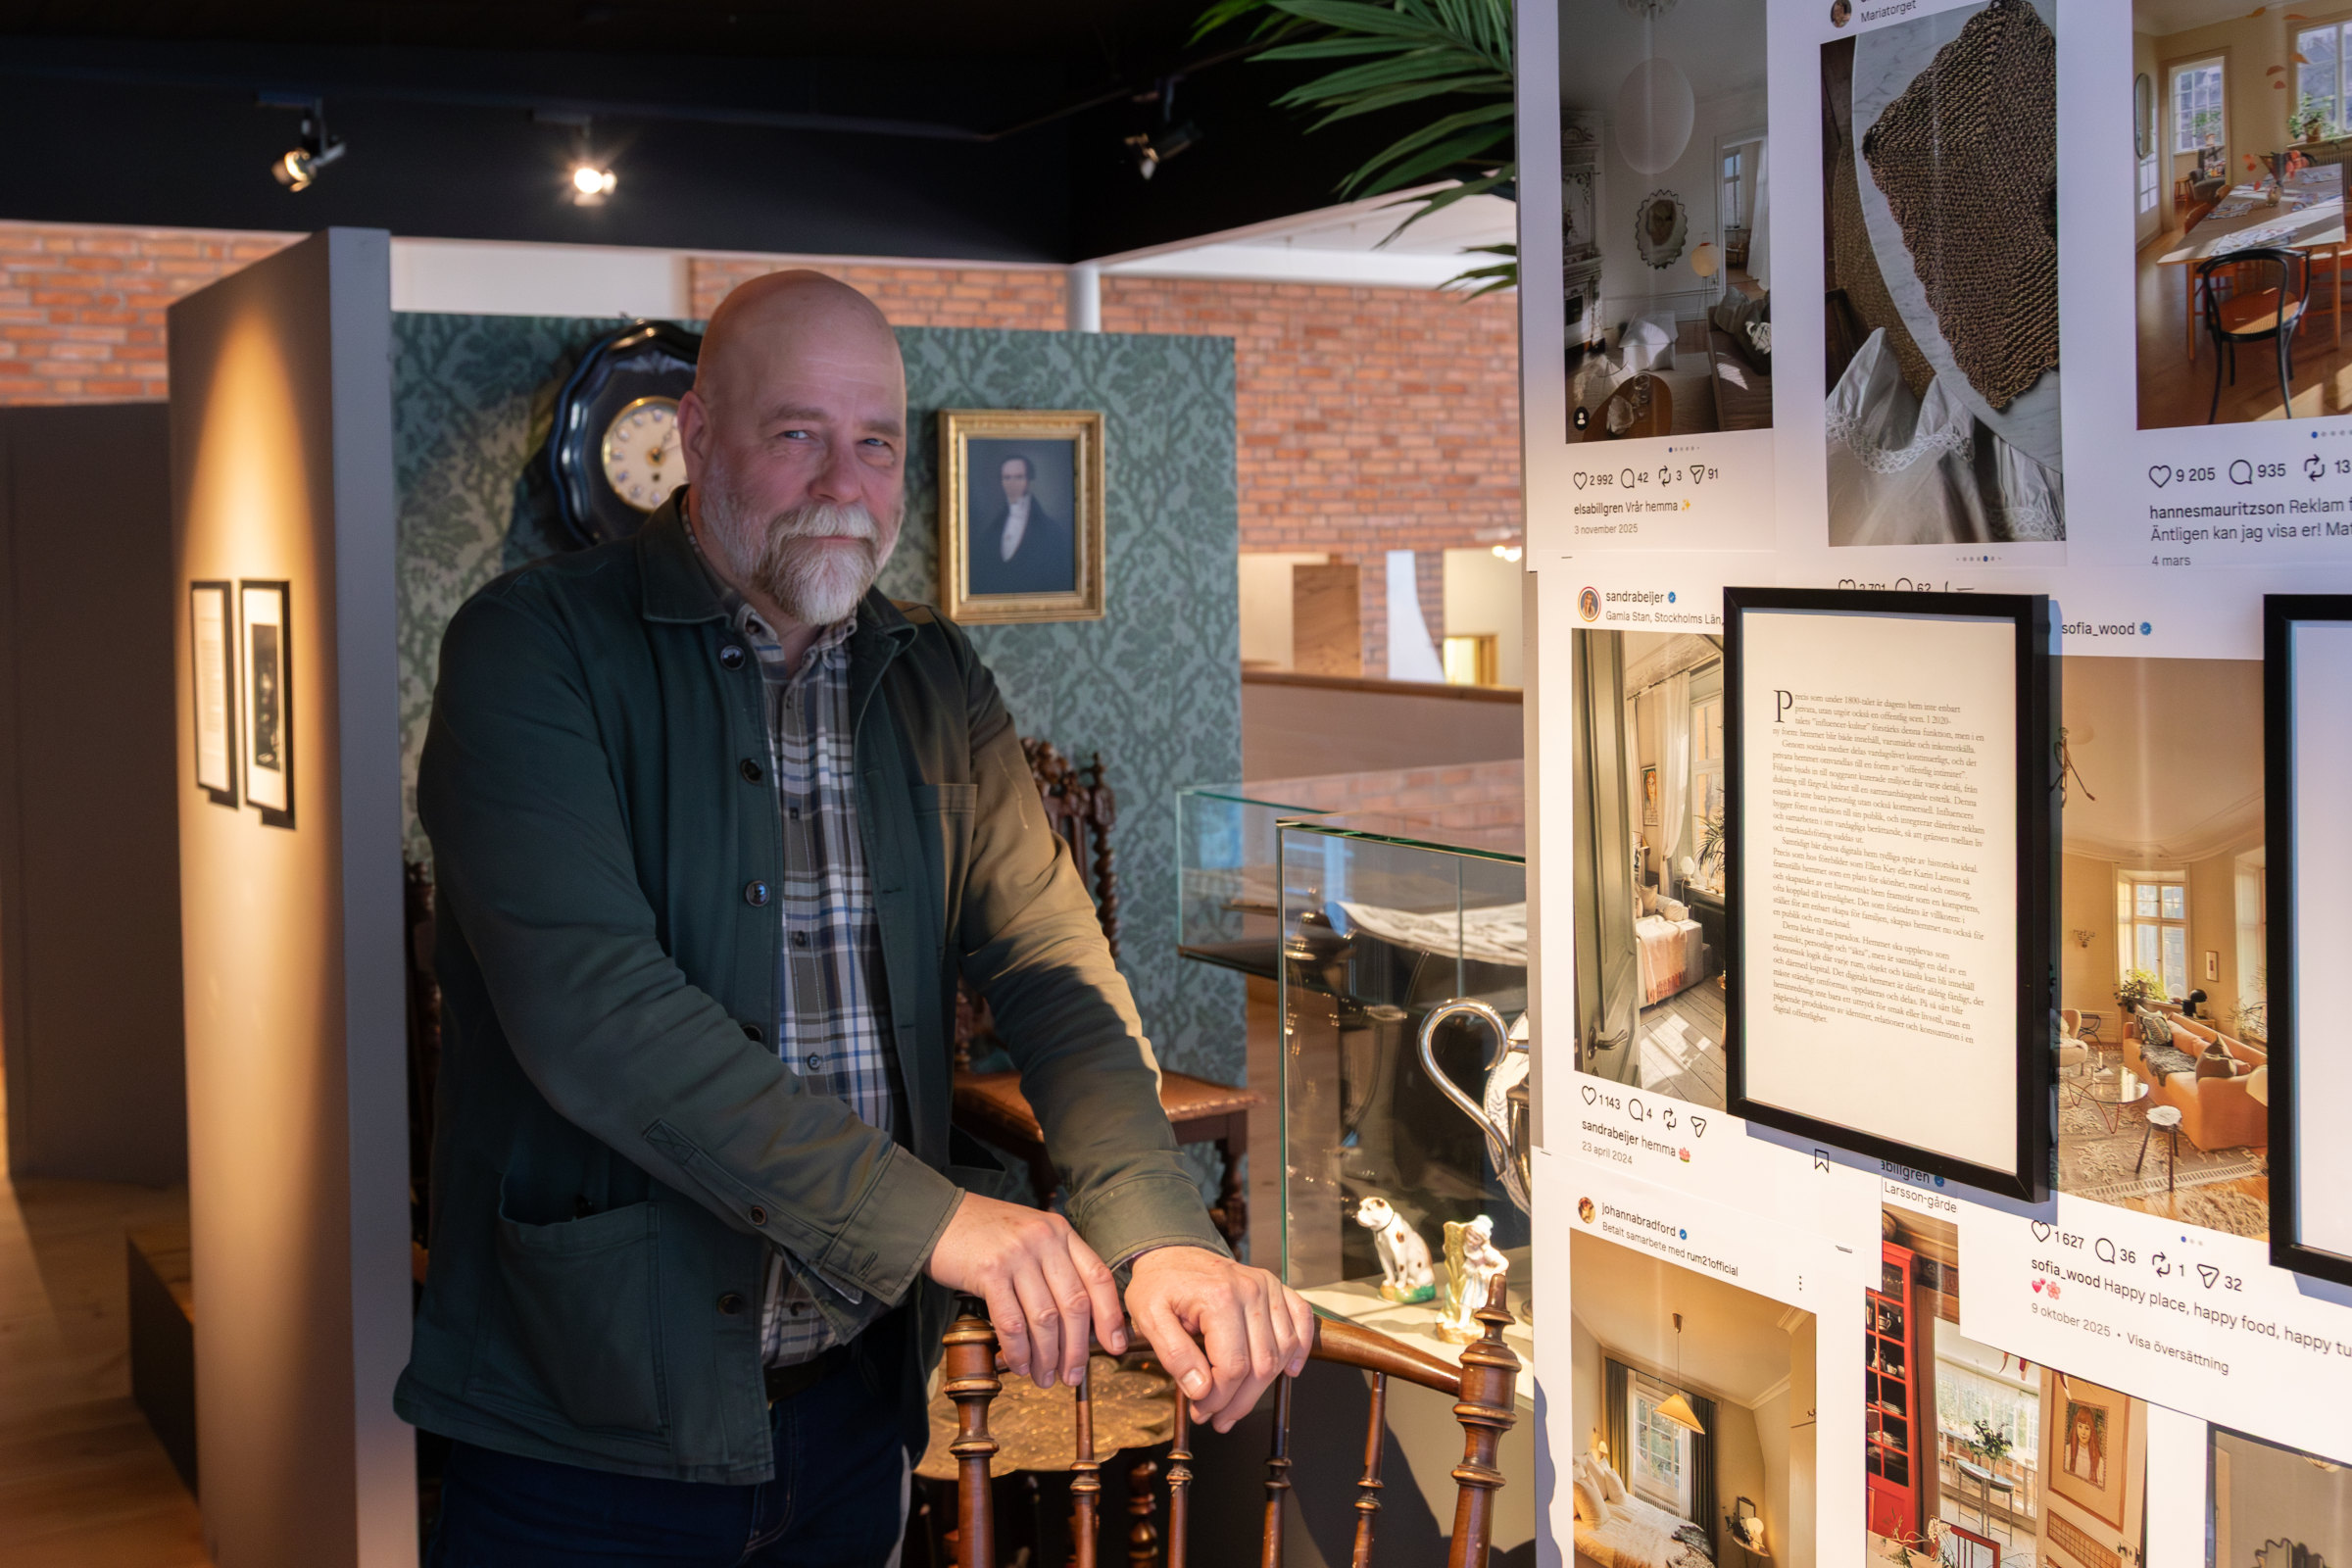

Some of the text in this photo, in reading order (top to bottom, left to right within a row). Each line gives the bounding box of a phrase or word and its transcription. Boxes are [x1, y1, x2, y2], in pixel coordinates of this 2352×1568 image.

[1861, 0, 1916, 23] Mariatorget
[1637, 472, 1649, 483] 42
[1676, 470, 1682, 481] 3
[1708, 469, 1719, 479] 91
[2176, 467, 2215, 482] 9 205
[2257, 464, 2286, 478] 935
[1574, 503, 1623, 516] elsabillgren
[1645, 500, 1678, 512] hemma
[2150, 502, 2285, 519] hannesmauritzson
[2289, 498, 2344, 514] Reklam
[1574, 524, 1638, 534] 3 november 2025
[2150, 524, 2209, 544] Äntligen
[2213, 526, 2237, 540] kan
[2240, 524, 2263, 543] jag
[2267, 523, 2297, 538] visa
[2302, 523, 2321, 537] er!
[2152, 555, 2191, 566] 4 mars
[1606, 591, 1664, 605] sandrabeijer
[1606, 611, 1630, 622] Gamla
[1632, 612, 1652, 623] Stan,
[1655, 612, 1703, 624] Stockholms
[2061, 622, 2136, 637] sofia_wood
[1646, 1108, 1652, 1118] 4
[1582, 1120, 1676, 1156] sandrabeijer hemma
[1582, 1141, 1633, 1164] 23 april 2024
[1884, 1181, 1957, 1213] Larsson-gårde
[1602, 1203, 1676, 1237] johannabradford
[1602, 1222, 1739, 1277] Betalt samarbete med rum21official
[2119, 1248, 2136, 1264] 36
[2179, 1264, 2185, 1277] 1
[2224, 1275, 2243, 1292] 32
[2031, 1257, 2101, 1288] sofia_wood
[2104, 1278, 2146, 1304] Happy
[2150, 1291, 2190, 1314] place,
[2194, 1302, 2238, 1330] happy
[2241, 1315, 2280, 1340] food,
[2284, 1326, 2332, 1355] happy
[2031, 1302, 2229, 1376] 9 oktober 2025 Visa översättning
